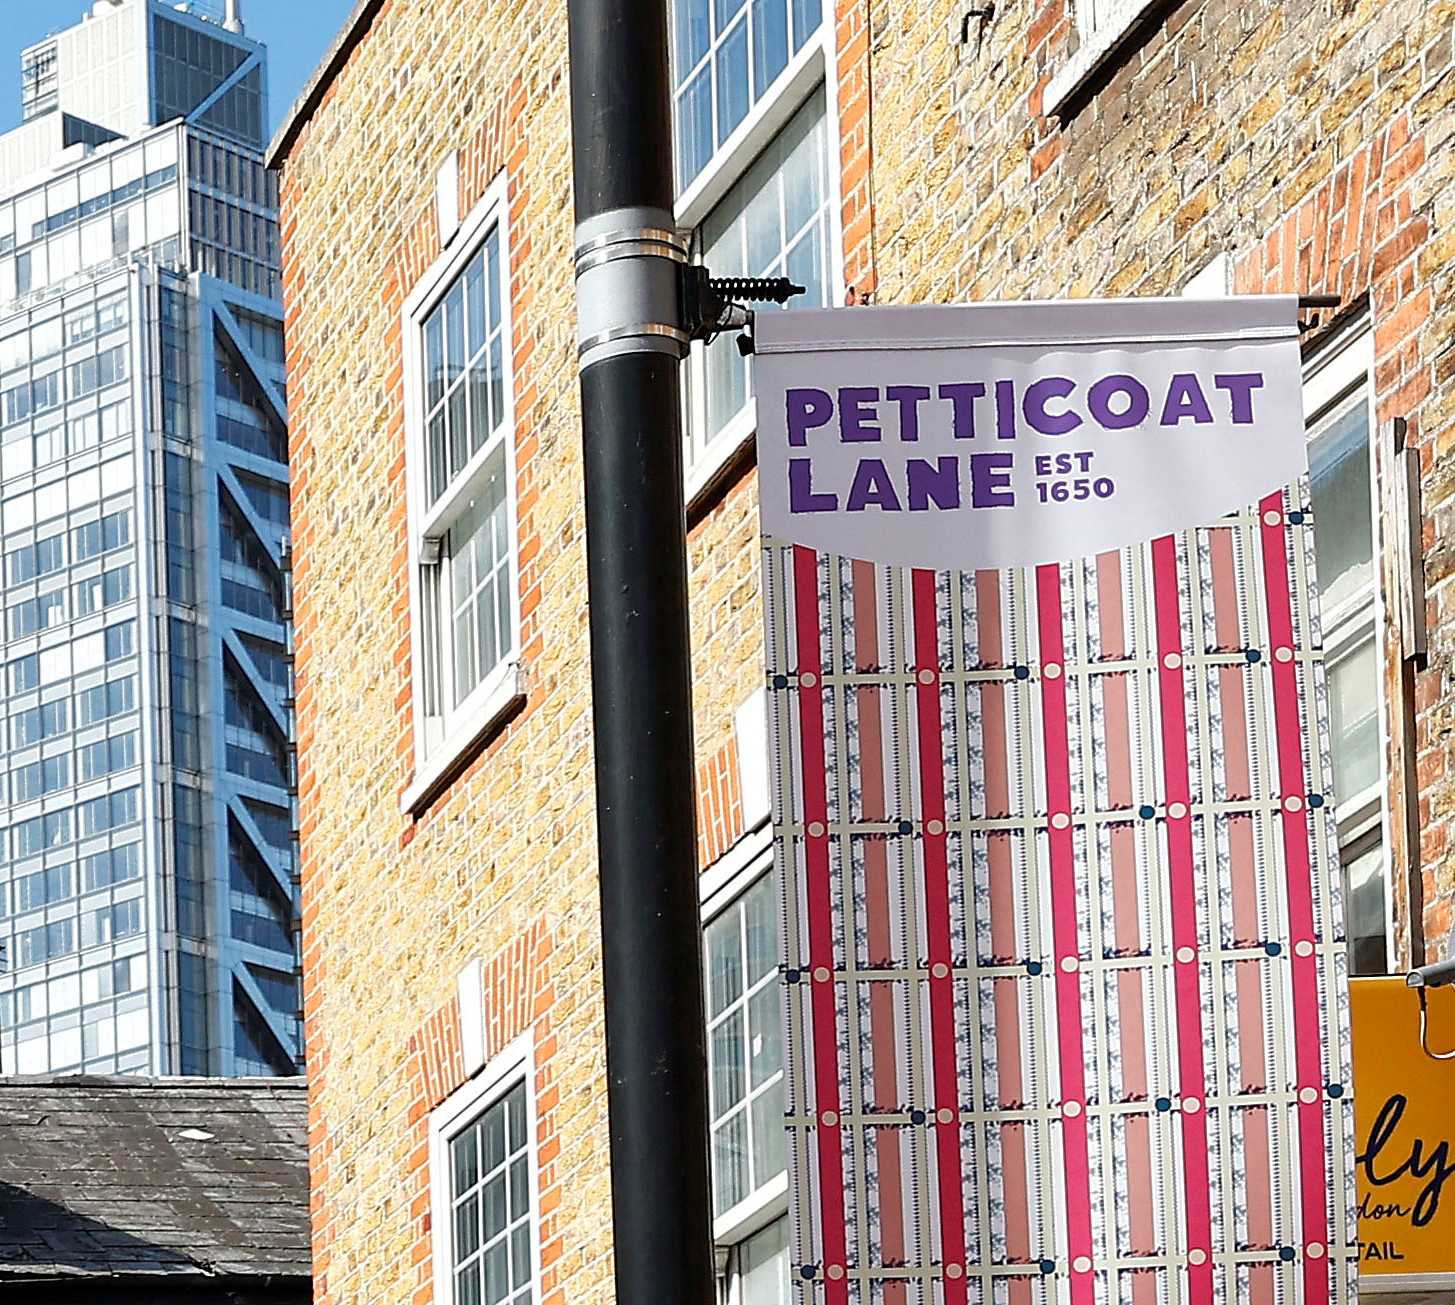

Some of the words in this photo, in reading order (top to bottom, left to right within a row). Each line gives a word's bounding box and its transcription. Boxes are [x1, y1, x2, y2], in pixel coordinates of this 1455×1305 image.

[785, 372, 1264, 448] PETTICOAT
[788, 452, 1015, 514] LANE
[1035, 451, 1095, 475] EST
[1036, 477, 1115, 504] 1650
